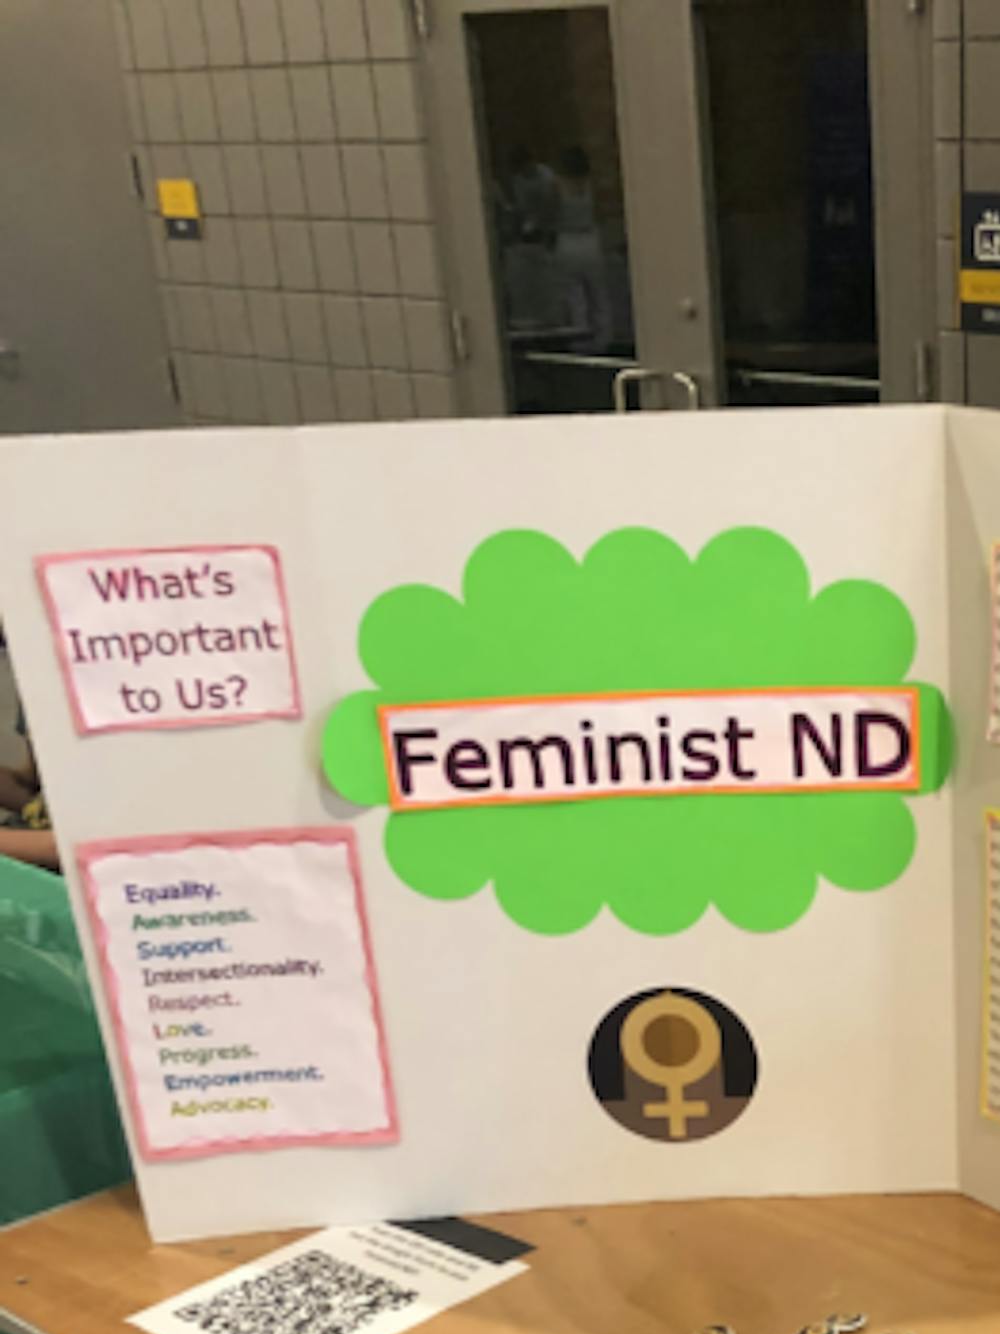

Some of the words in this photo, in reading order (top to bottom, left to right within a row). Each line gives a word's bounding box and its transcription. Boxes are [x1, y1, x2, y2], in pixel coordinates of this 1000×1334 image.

[89, 564, 235, 602] What's
[67, 618, 282, 664] Important
[119, 684, 161, 713] to
[175, 675, 248, 710] Us?
[392, 715, 756, 796] Feminist
[790, 709, 911, 778] ND
[124, 881, 221, 904] Equality.
[132, 907, 257, 931] Awareness.
[137, 937, 231, 960] Support.
[141, 958, 324, 987] Intersectionality.
[148, 991, 240, 1014] Respect.
[153, 1022, 212, 1040] Love.
[159, 1045, 258, 1065] Progress.
[164, 1065, 324, 1092] Empowerment.
